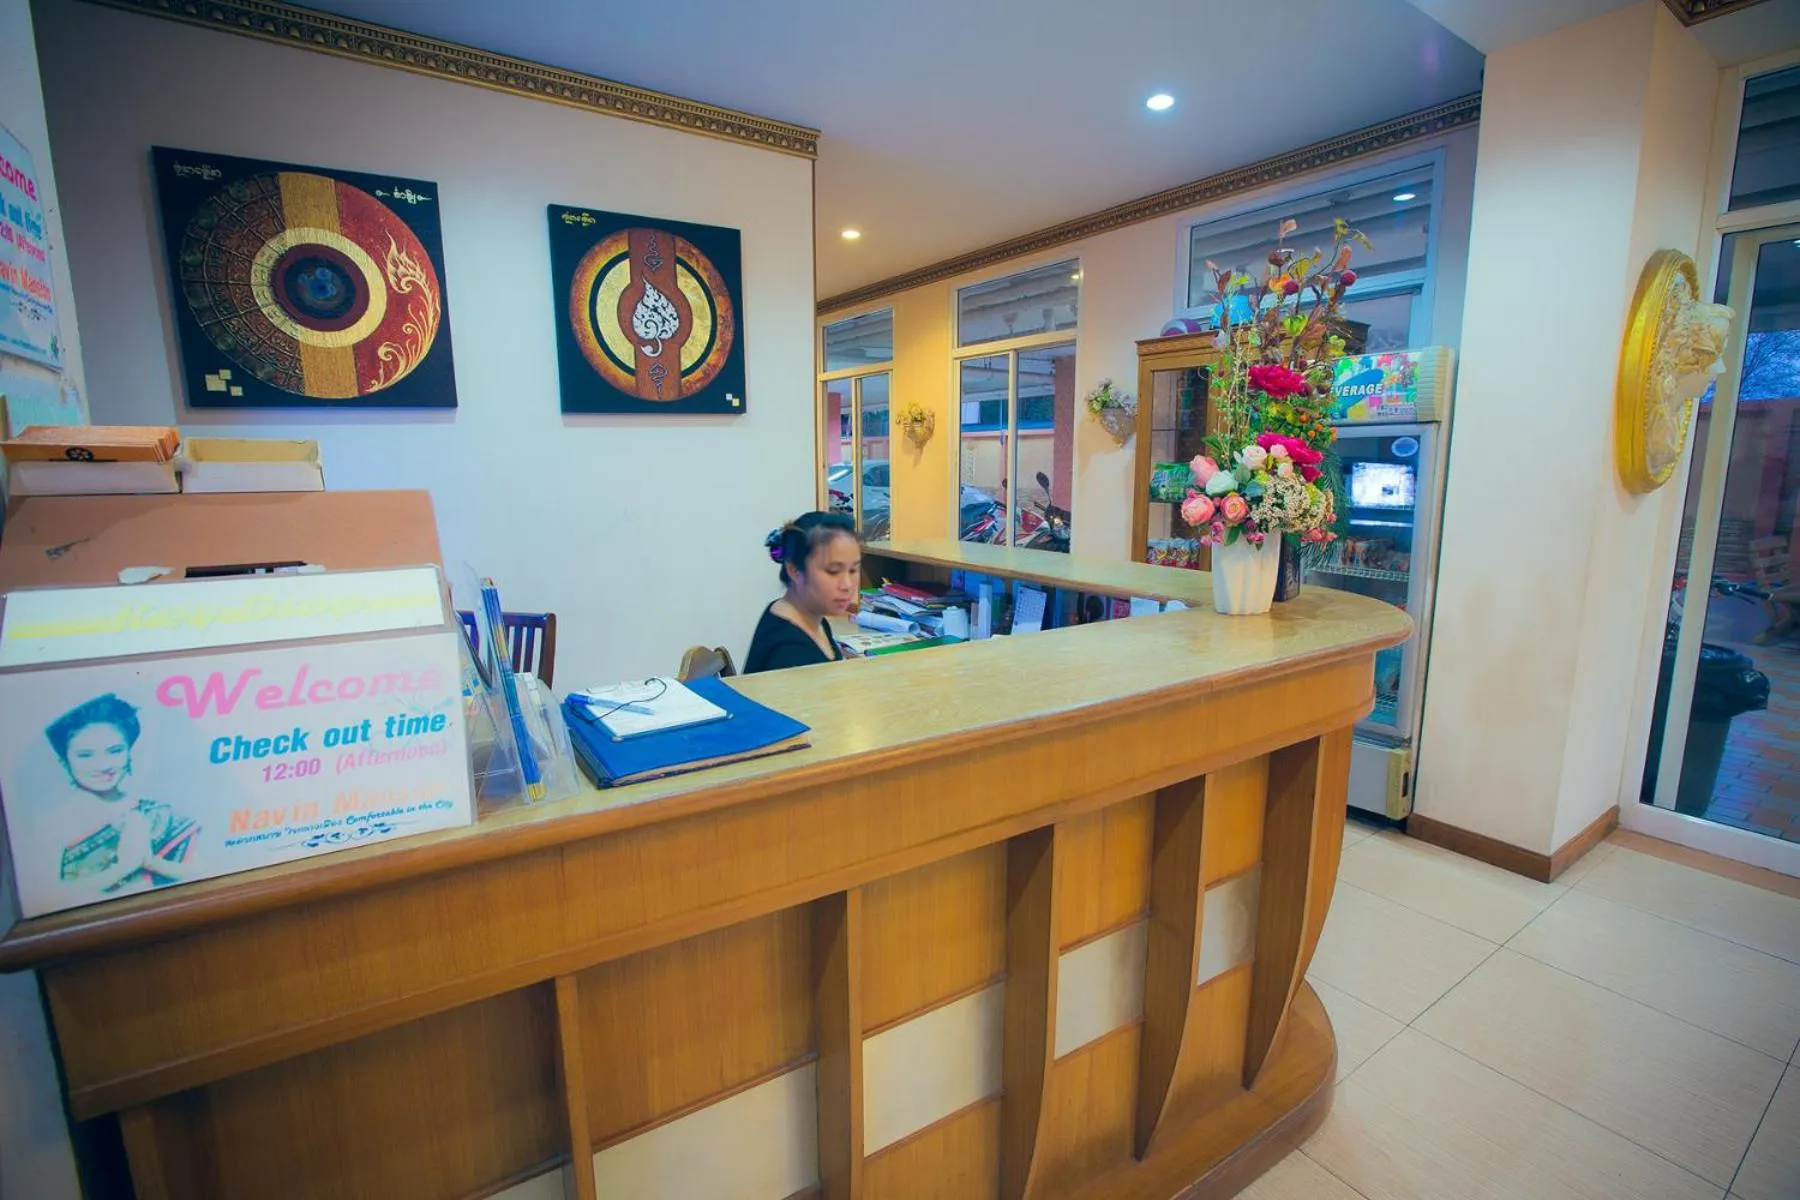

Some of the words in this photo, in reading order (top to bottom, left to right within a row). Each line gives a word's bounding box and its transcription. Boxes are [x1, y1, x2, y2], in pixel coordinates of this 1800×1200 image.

[155, 662, 444, 719] Welcome
[209, 727, 310, 765] Check
[323, 718, 372, 748] out
[384, 713, 447, 739] time
[262, 757, 322, 783] 12:00
[228, 802, 319, 834] Navin
